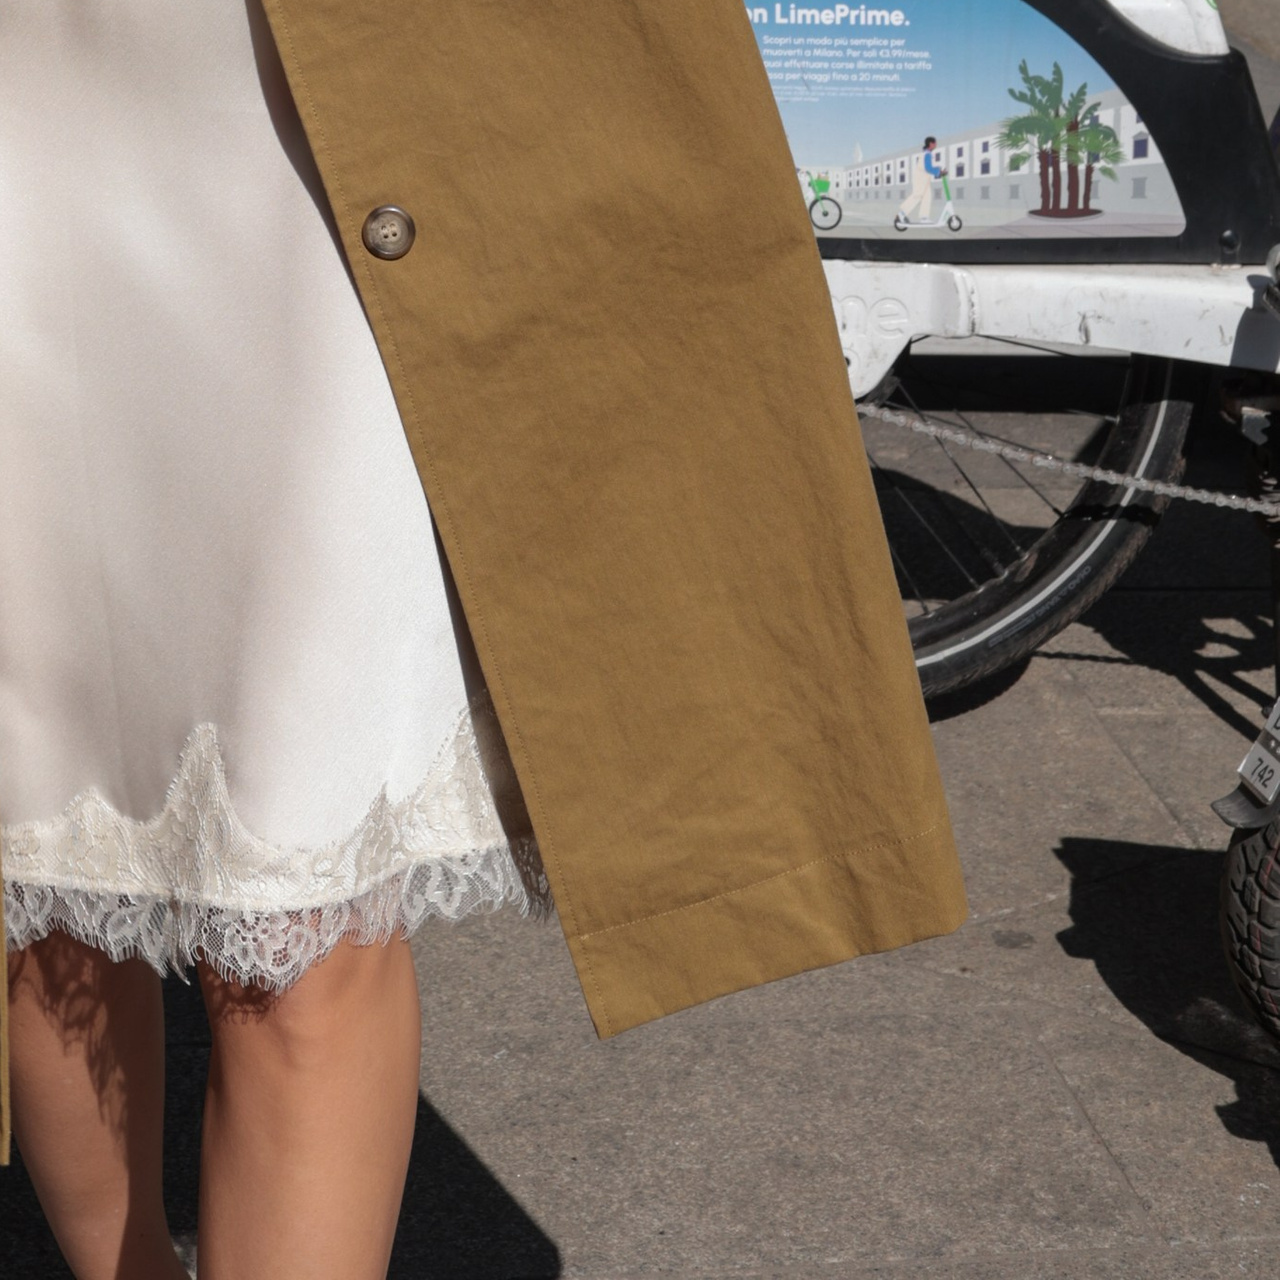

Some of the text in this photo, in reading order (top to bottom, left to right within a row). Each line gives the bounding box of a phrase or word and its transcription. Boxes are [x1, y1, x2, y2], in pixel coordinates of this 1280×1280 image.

[775, 3, 910, 26] LimePrime.
[762, 35, 792, 46] Scopri
[793, 37, 805, 45] un
[806, 36, 832, 45] modo
[849, 37, 889, 47] semplice
[890, 38, 906, 48] per
[763, 48, 802, 56] muoverti
[846, 49, 860, 57] Per
[863, 49, 877, 58] soli
[784, 59, 829, 69] effettuare
[831, 61, 854, 69] corse
[896, 62, 903, 70] a
[904, 61, 933, 71] tariffa
[785, 73, 801, 81] per
[803, 72, 830, 83] viaggi
[832, 72, 849, 81] fino
[859, 73, 870, 81] 20
[1251, 757, 1274, 788] 742
